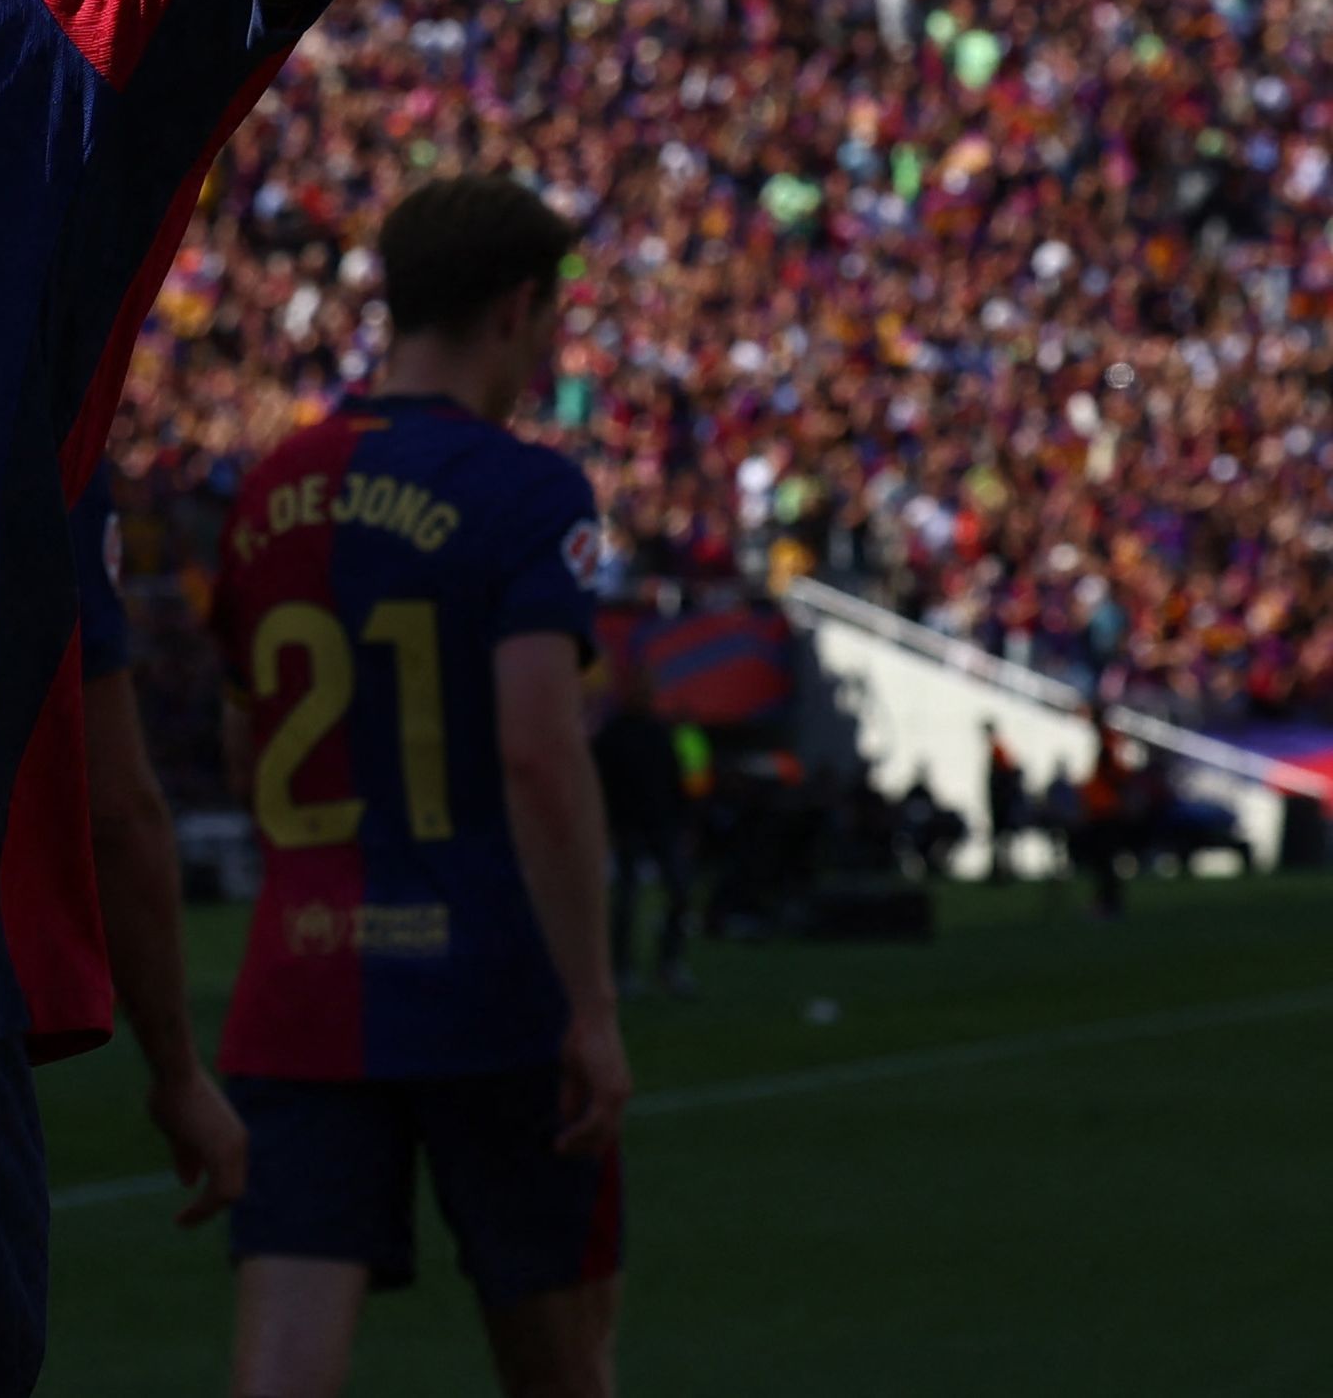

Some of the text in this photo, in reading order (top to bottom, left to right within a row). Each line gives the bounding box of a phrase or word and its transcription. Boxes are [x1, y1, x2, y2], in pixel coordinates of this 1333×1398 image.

[267, 472, 331, 538] DE
[330, 472, 462, 554] JONG
[250, 598, 456, 851] 21
